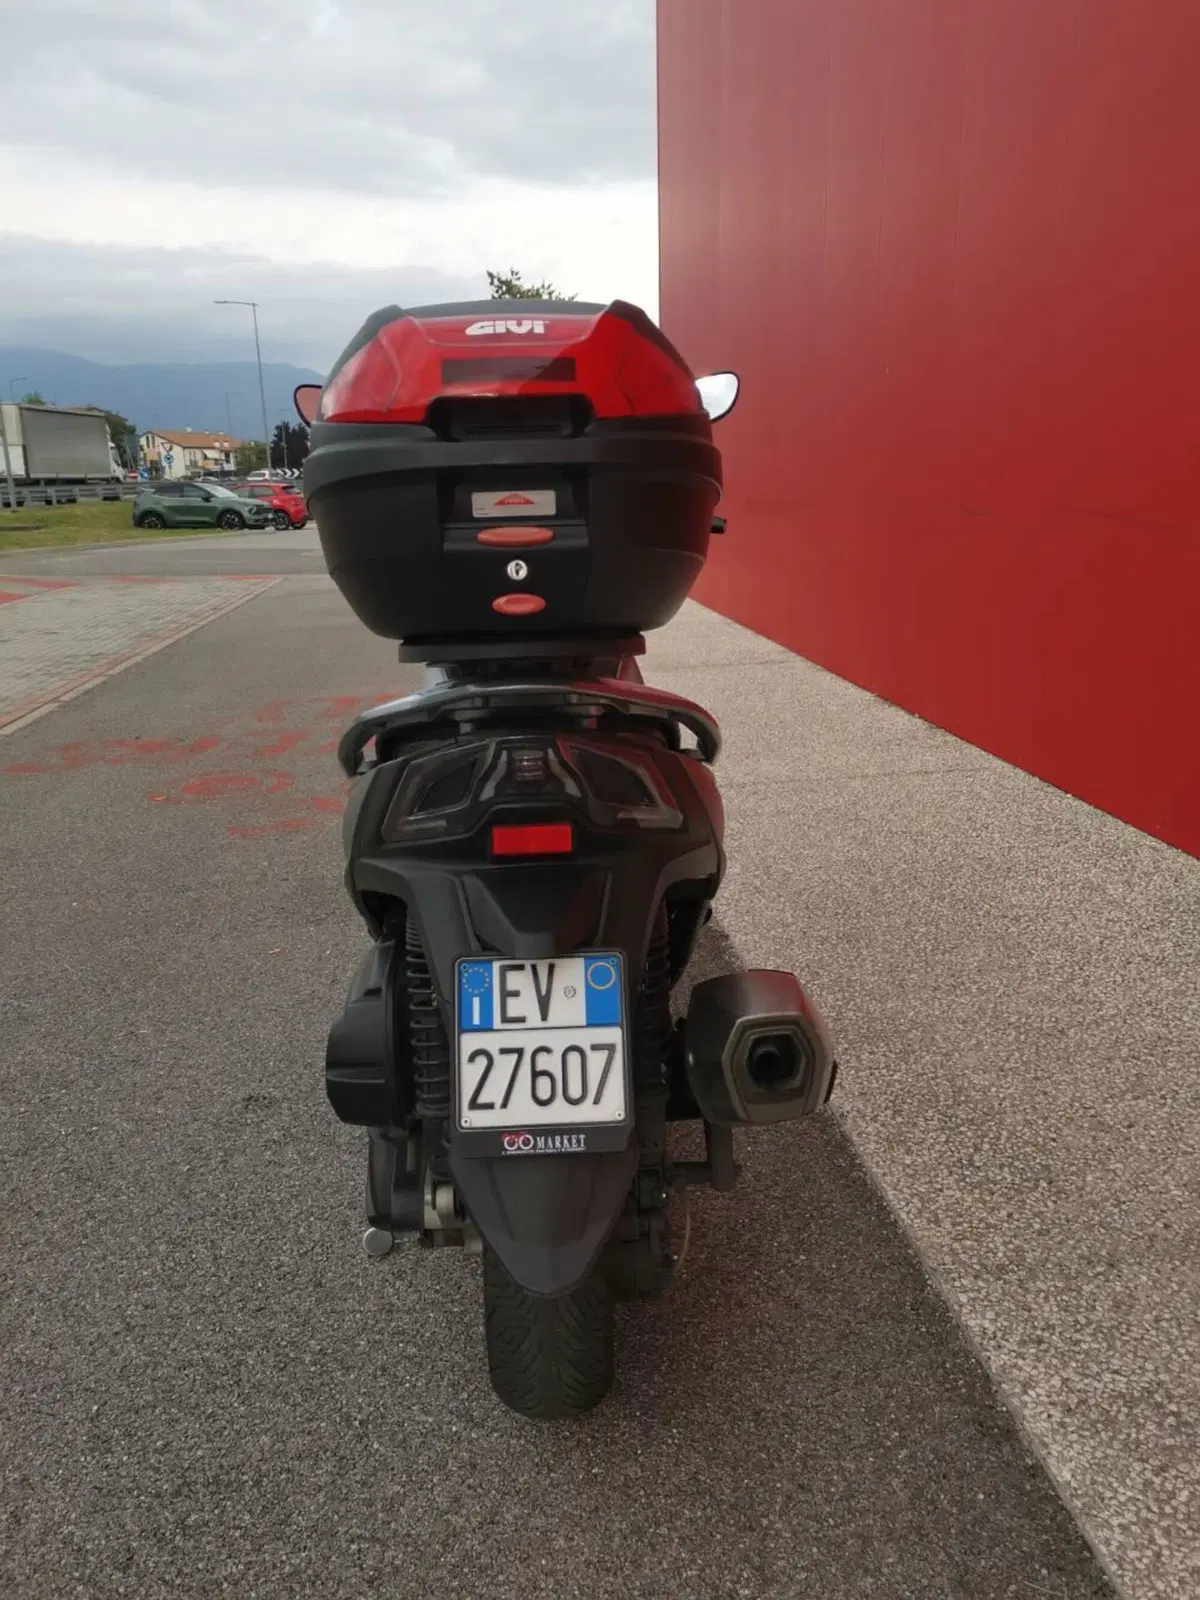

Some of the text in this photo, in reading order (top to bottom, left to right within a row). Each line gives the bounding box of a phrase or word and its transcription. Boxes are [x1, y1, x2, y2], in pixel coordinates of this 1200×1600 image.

[465, 320, 545, 335] GIVI
[500, 963, 555, 1024] EV
[467, 1043, 617, 1110] 27607
[537, 1134, 586, 1149] MARKET
